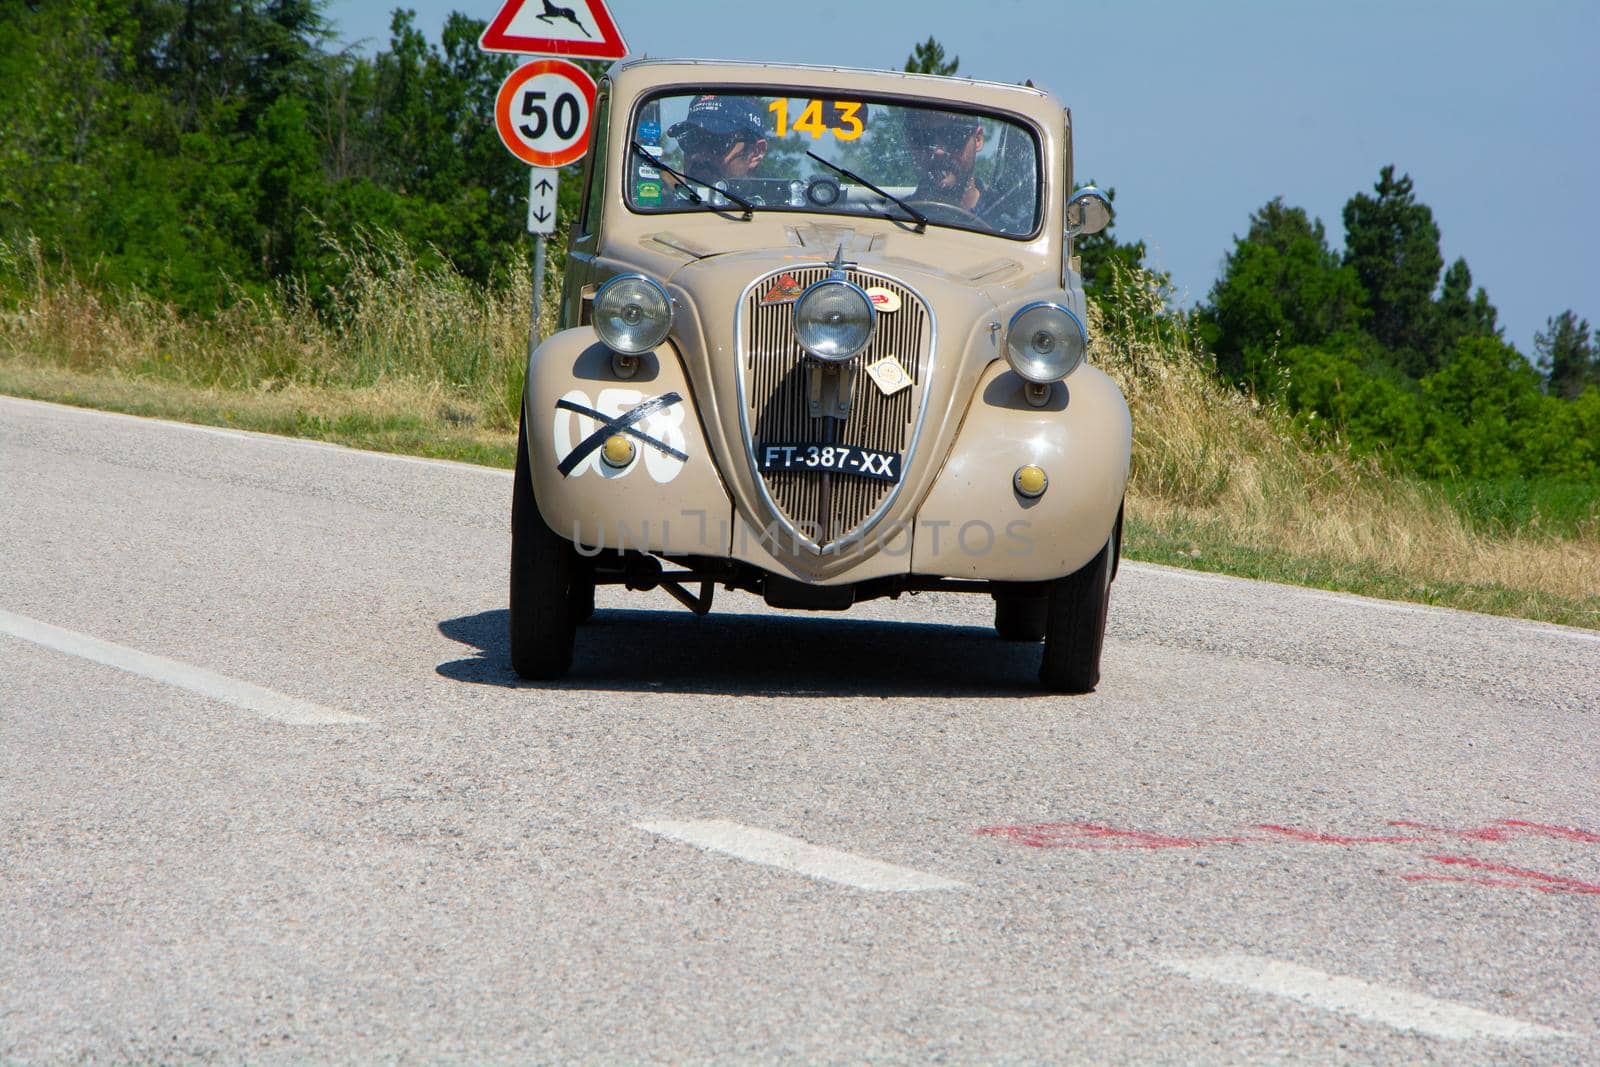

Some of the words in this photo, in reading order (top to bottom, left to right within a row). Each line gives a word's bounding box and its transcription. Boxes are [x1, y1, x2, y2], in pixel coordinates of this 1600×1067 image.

[519, 91, 580, 140] 50
[768, 97, 864, 141] 143
[765, 445, 894, 478] FT-387-XX
